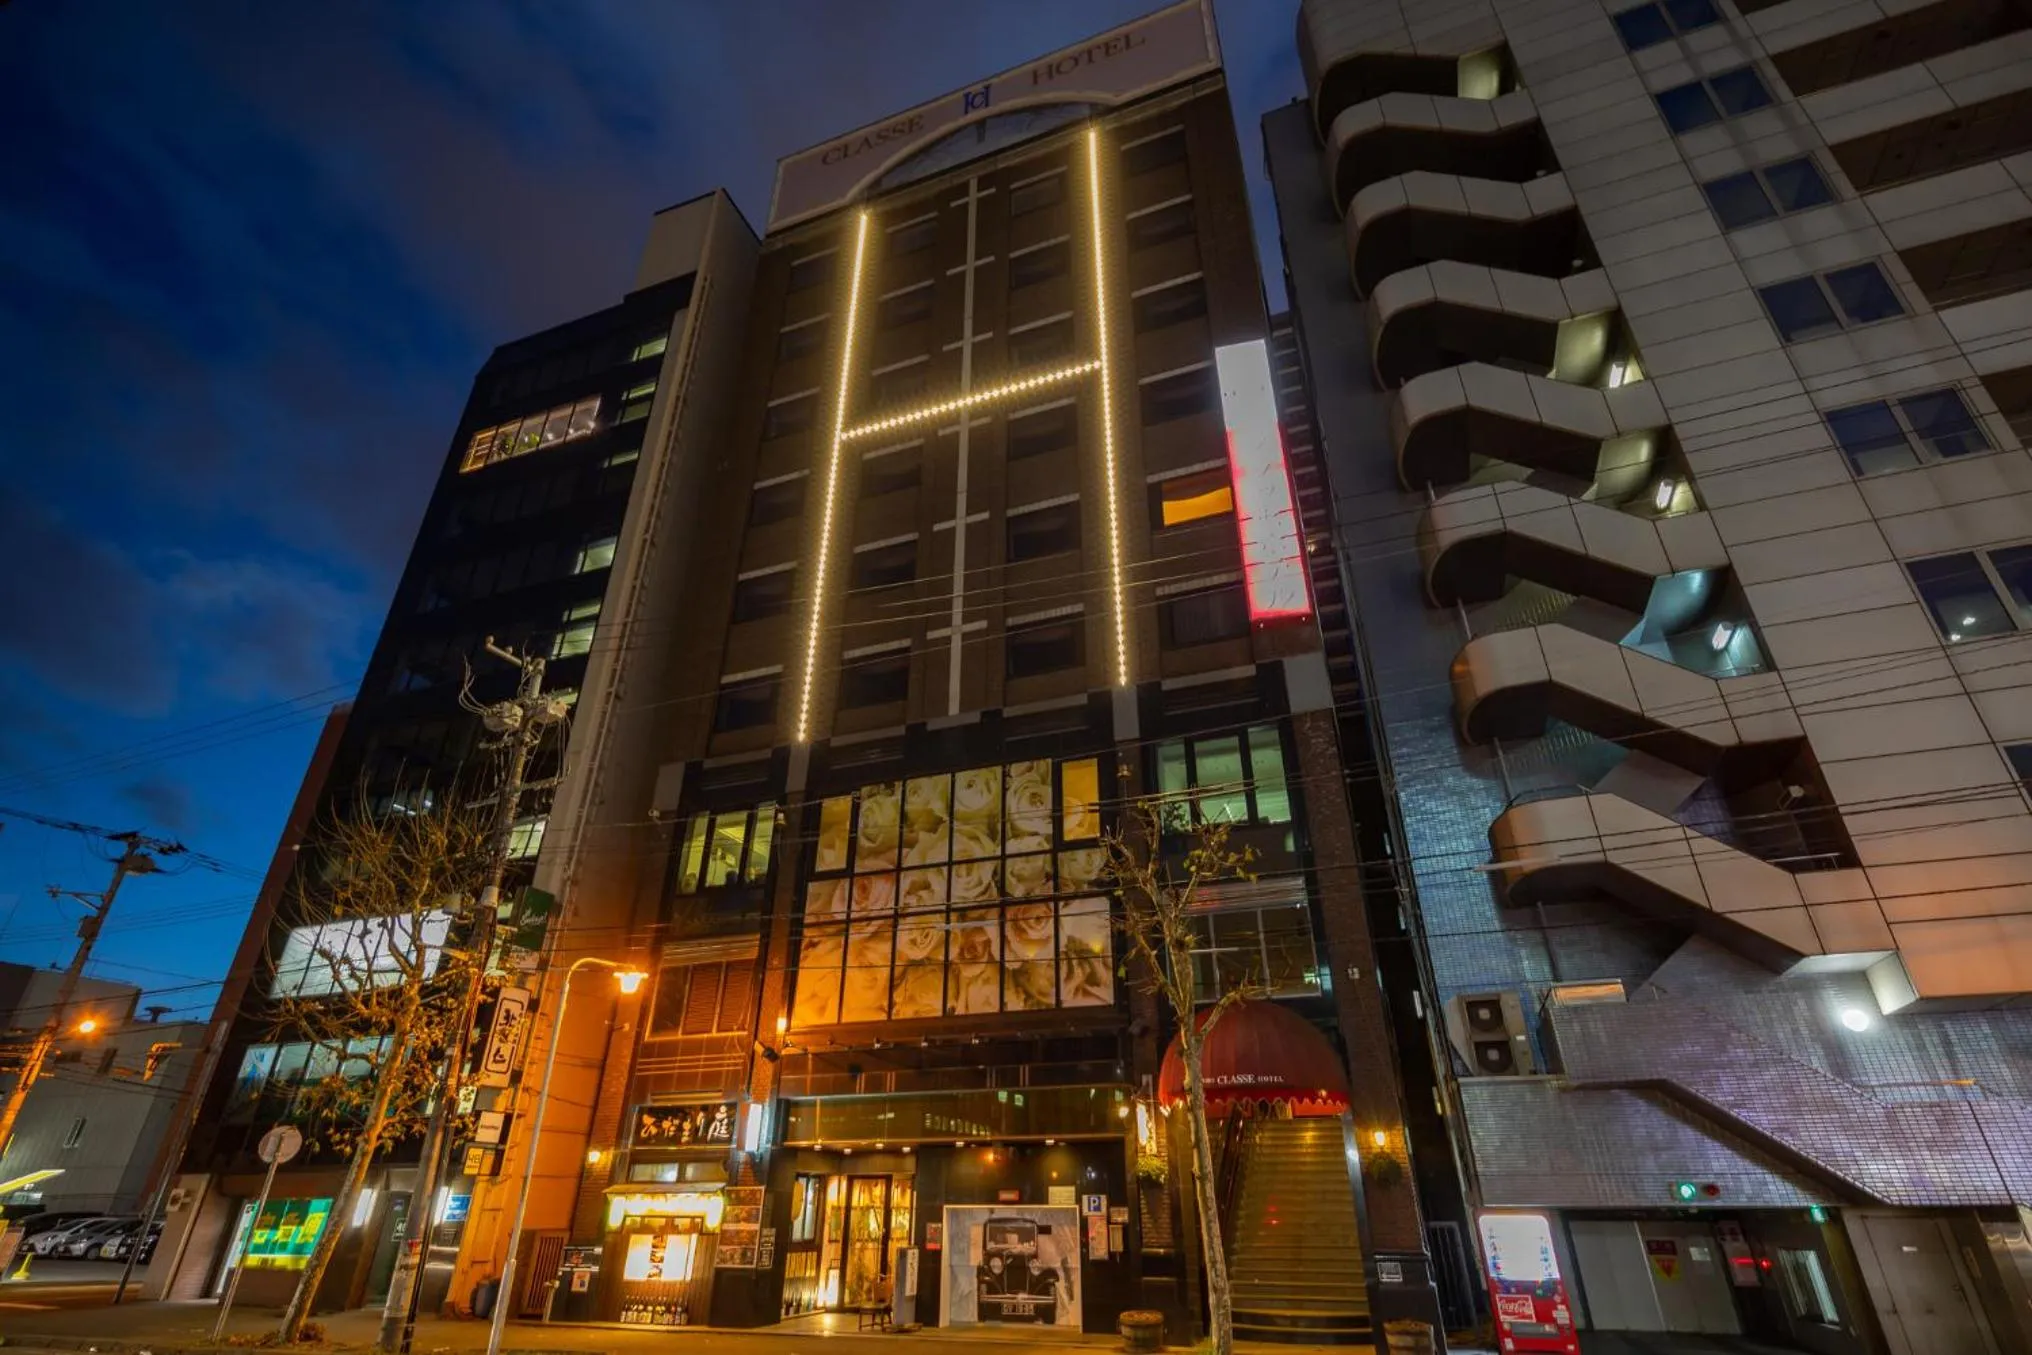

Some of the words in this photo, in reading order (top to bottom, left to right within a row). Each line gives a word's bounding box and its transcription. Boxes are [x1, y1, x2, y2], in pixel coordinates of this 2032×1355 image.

[821, 113, 925, 167] CLASSE
[1031, 32, 1147, 87] HOTEL
[1217, 1073, 1256, 1085] CLASSE
[1257, 1074, 1284, 1084] HOTEL
[1090, 1197, 1100, 1212] P
